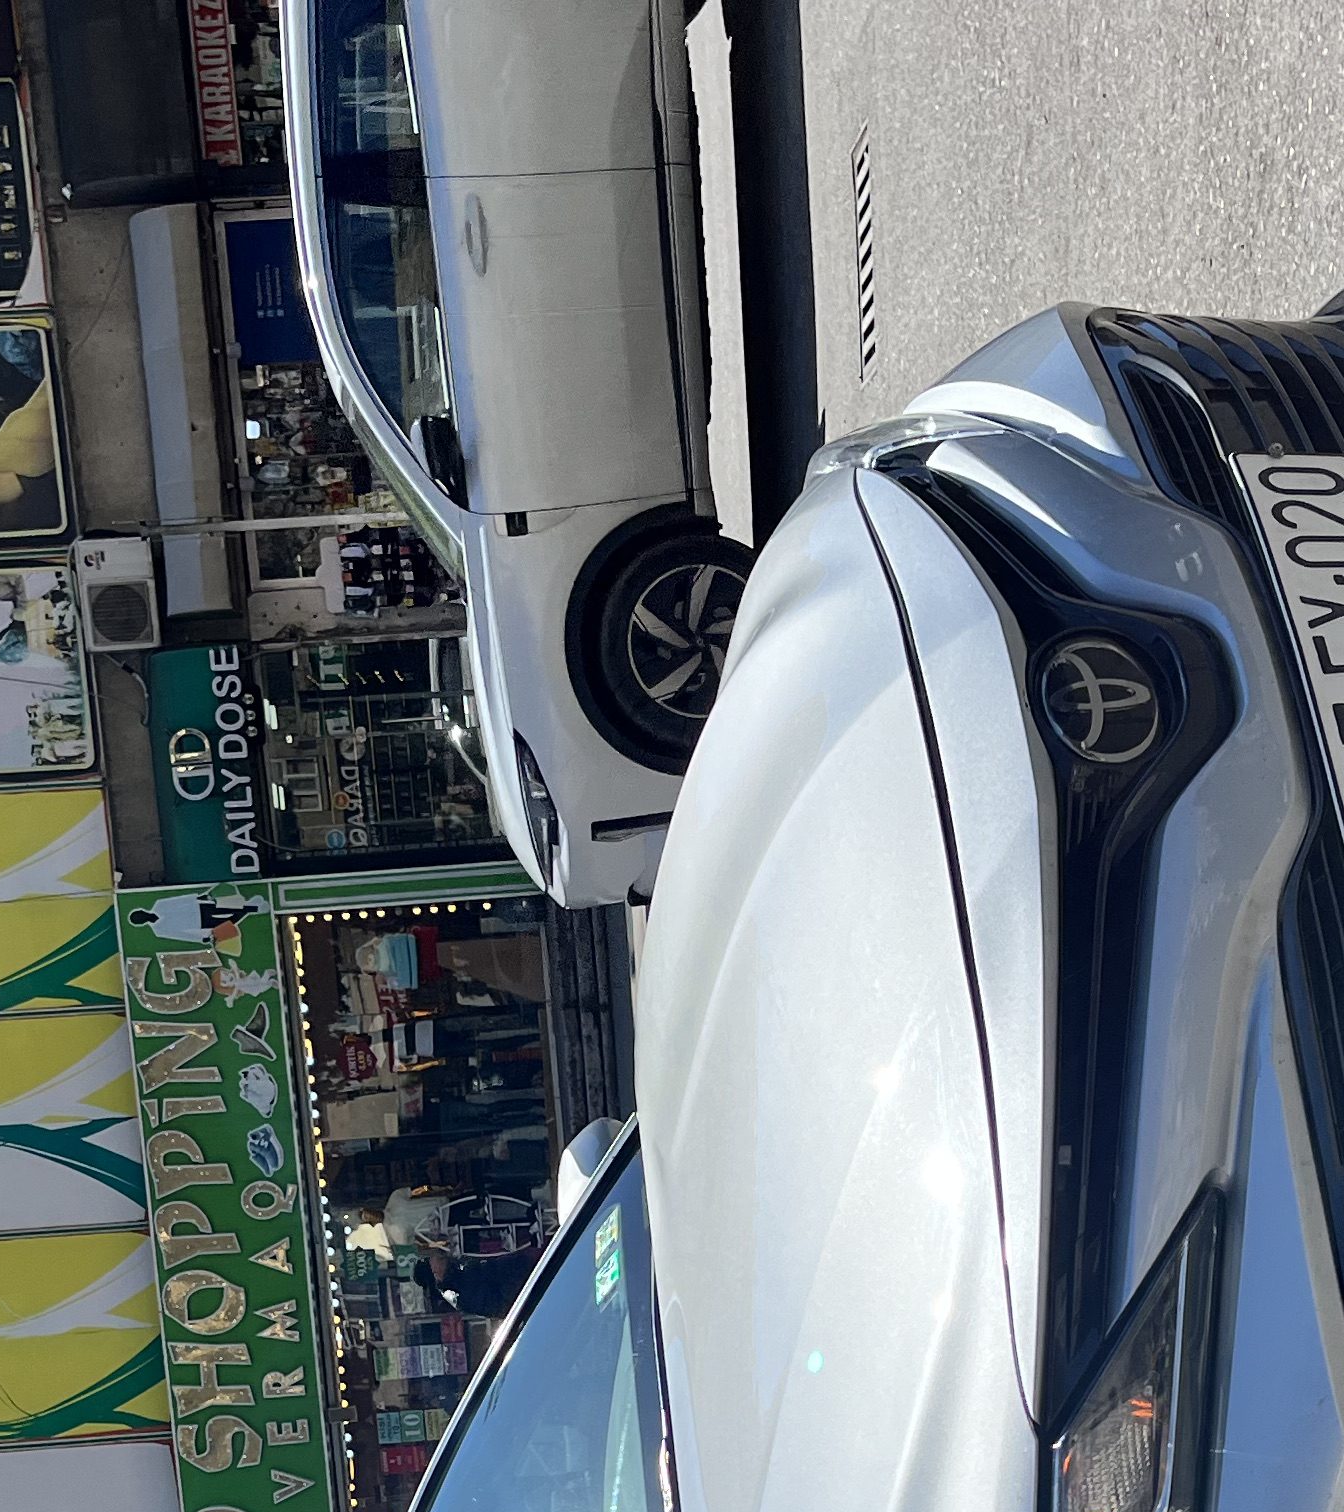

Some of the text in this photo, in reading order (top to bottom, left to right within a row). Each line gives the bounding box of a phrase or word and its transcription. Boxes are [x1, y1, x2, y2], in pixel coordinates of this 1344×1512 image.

[195, 14, 236, 141] KARAOKE
[209, 646, 260, 873] DAILY DOSE
[403, 1414, 420, 1438] 10
